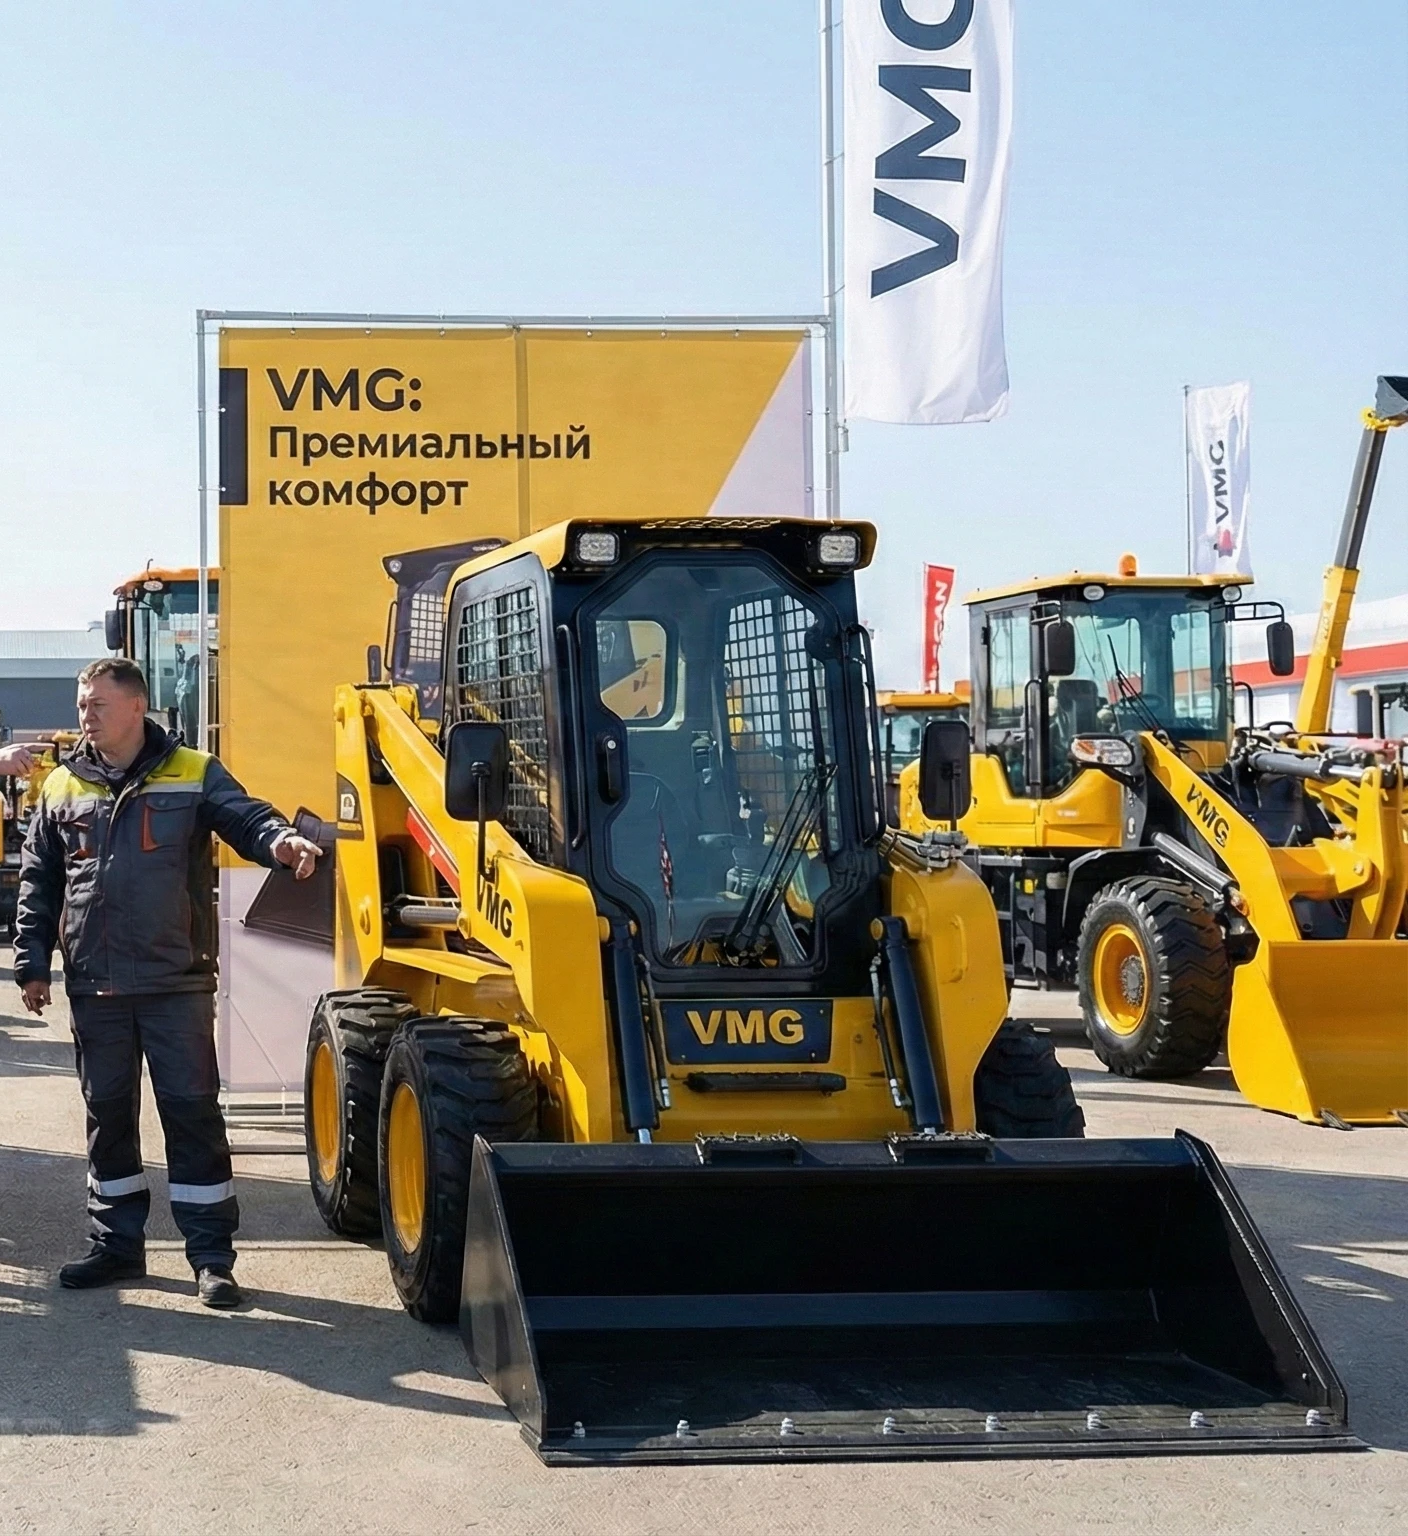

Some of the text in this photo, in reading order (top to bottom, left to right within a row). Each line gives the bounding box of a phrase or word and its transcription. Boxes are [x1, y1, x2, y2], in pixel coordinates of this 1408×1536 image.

[266, 367, 422, 412] VMG:
[269, 424, 591, 467] Премиальный
[269, 471, 469, 516] комфорт
[477, 872, 512, 939] VMG
[687, 1009, 804, 1044] VMG
